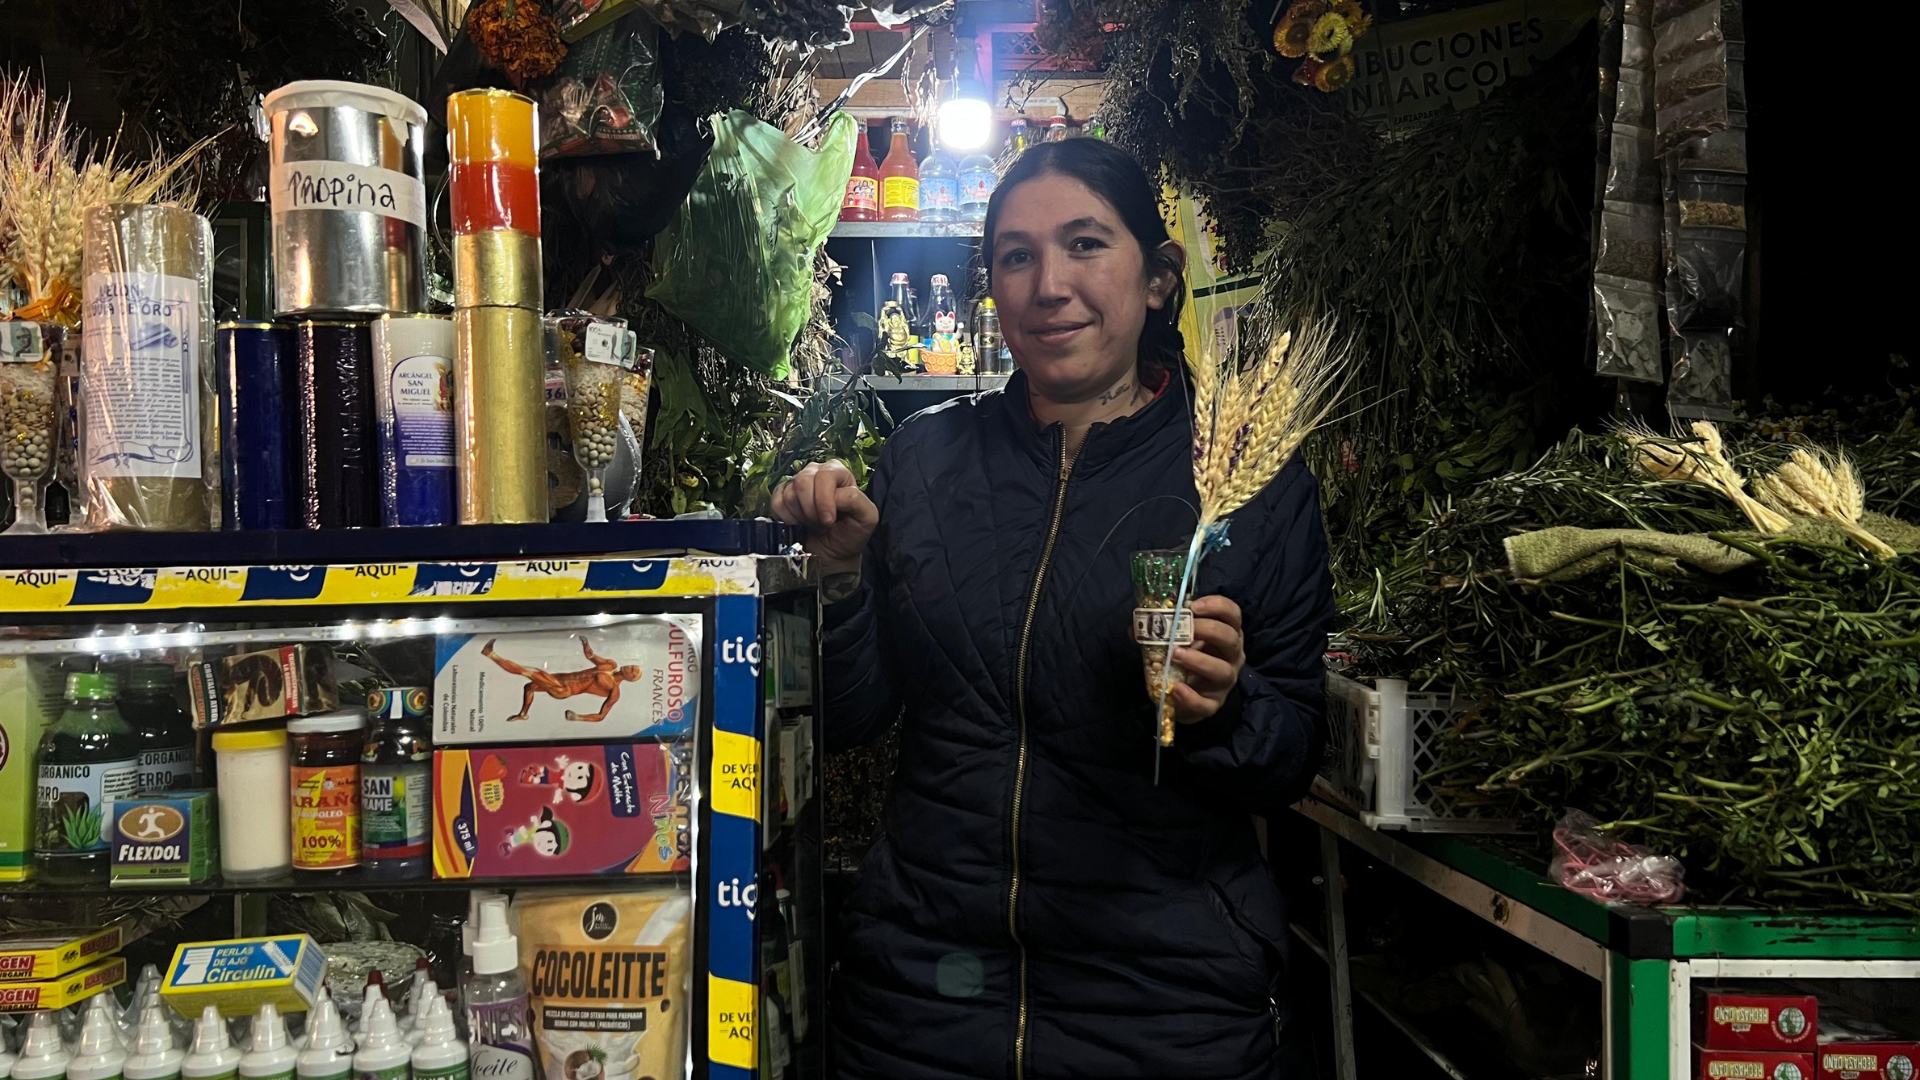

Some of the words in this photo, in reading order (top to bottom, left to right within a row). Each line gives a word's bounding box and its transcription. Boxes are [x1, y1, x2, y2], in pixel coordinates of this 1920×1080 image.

[398, 371, 433, 379] ARCÁNGEL
[400, 388, 431, 396] MIGUEL
[443, 693, 449, 701] de
[652, 669, 665, 724] FRANCÉS
[610, 762, 620, 774] de
[722, 763, 737, 774] DE
[457, 822, 471, 840] 375
[302, 835, 342, 848] 100%
[463, 840, 475, 852] ml
[118, 844, 182, 862] FLEXDOL
[216, 946, 254, 957] PERLAS
[0, 955, 32, 971] GEN
[213, 958, 226, 966] DE
[227, 956, 248, 966] AJO
[206, 965, 276, 983] Circulin
[532, 949, 667, 999] COCOLEITTE
[719, 1012, 735, 1023] DE
